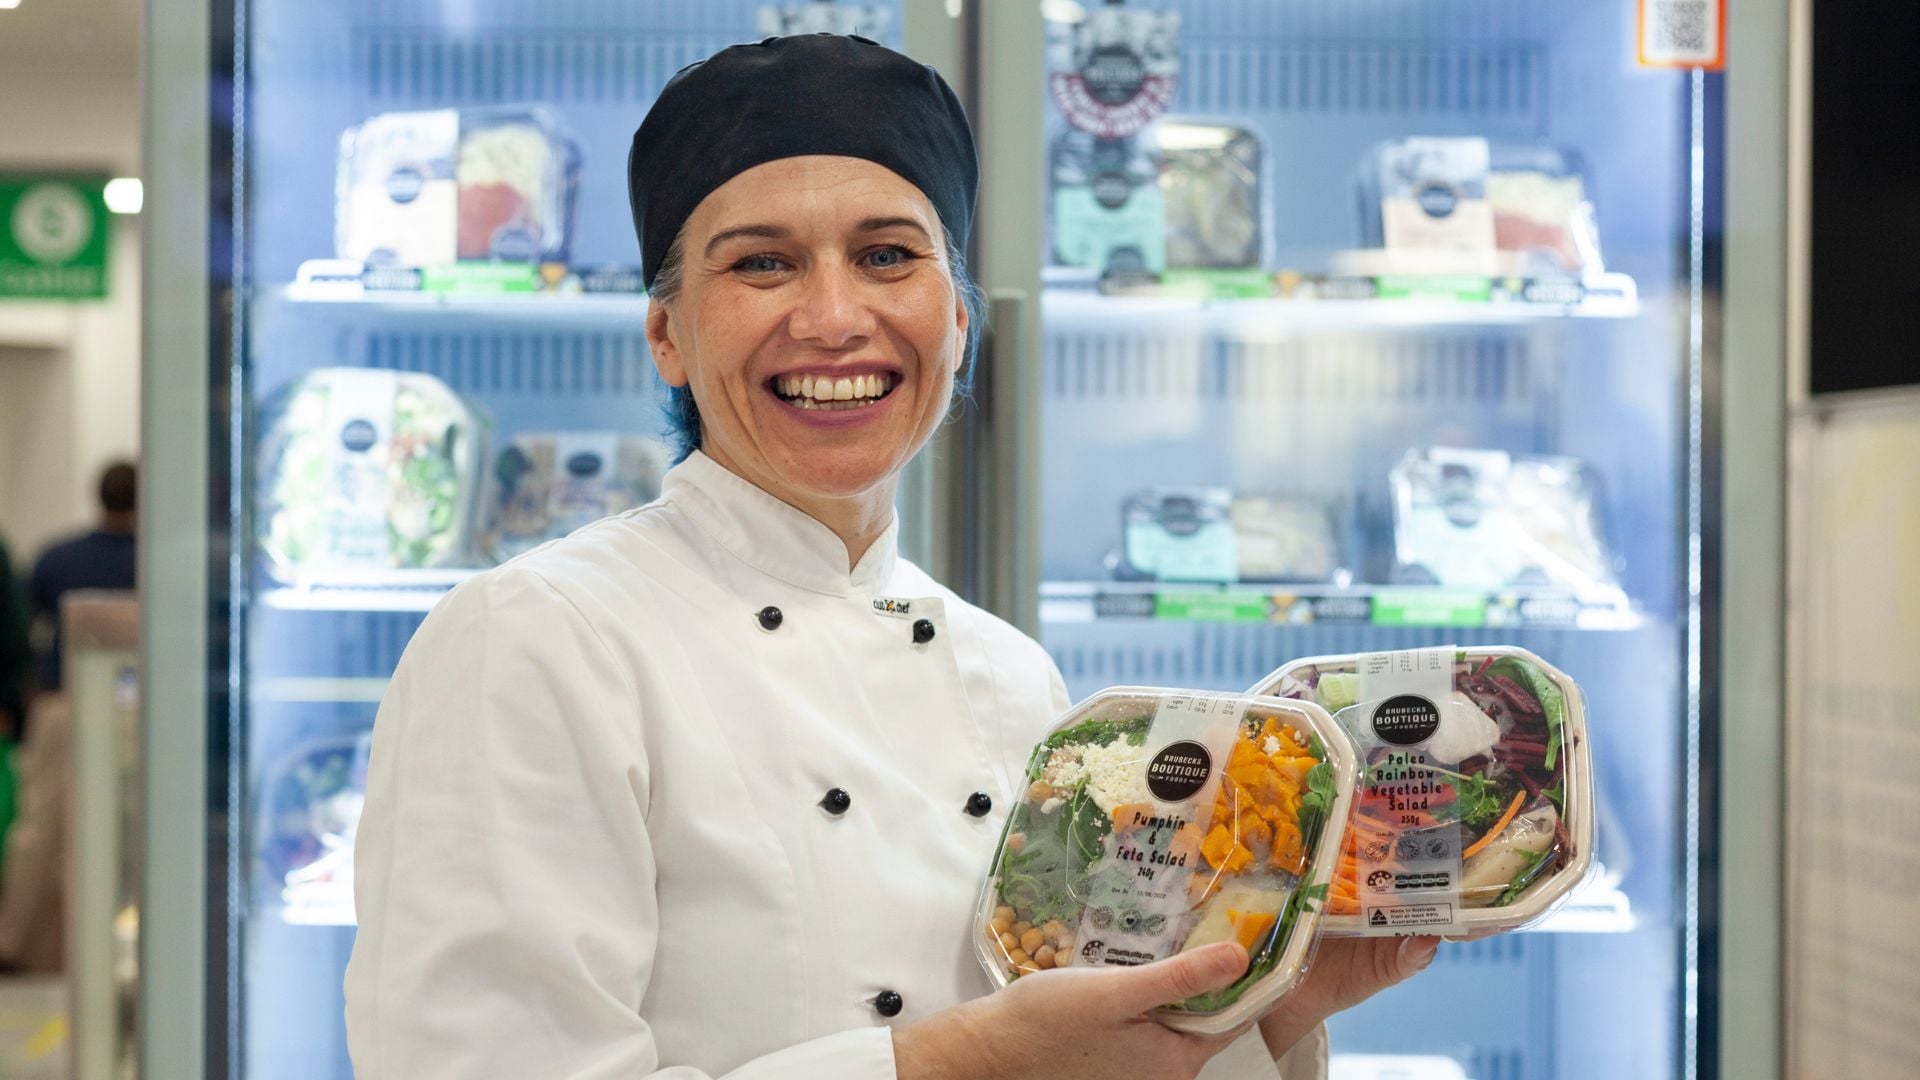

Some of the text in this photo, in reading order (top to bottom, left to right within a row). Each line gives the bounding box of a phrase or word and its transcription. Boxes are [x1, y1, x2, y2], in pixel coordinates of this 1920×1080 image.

[1385, 706, 1426, 715] BRUBECKS
[1376, 713, 1436, 725] BOUTIQUE
[1164, 755, 1202, 765] BRUBECKS
[1388, 752, 1425, 765] Paleo
[1151, 763, 1208, 778] BOUTIQUE
[1377, 767, 1434, 782] Rainbow
[1165, 776, 1188, 784] FOODS
[1371, 781, 1442, 799] Vegetable
[1389, 797, 1428, 811] Salad
[1133, 811, 1186, 832] Pumpkin
[1401, 815, 1420, 826] 250g
[1148, 831, 1157, 845] &
[1116, 845, 1187, 867] Feta Salad
[1137, 867, 1155, 881] 240g
